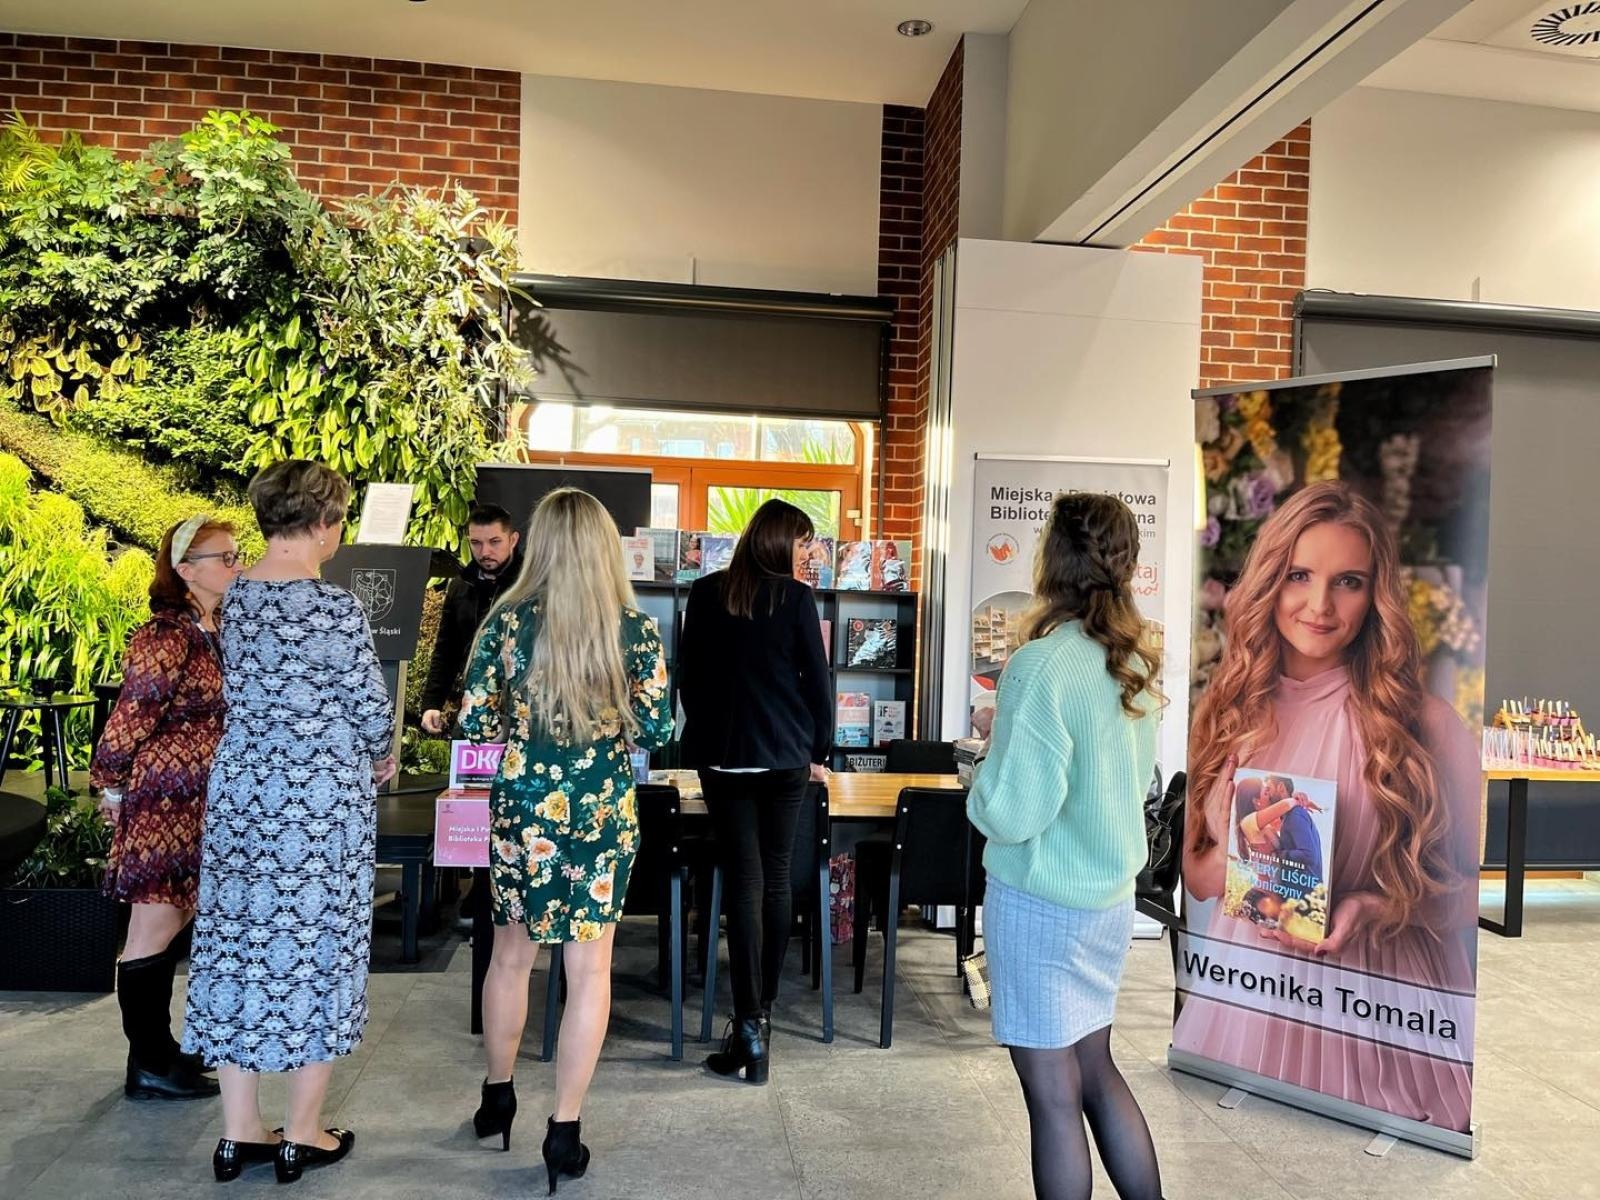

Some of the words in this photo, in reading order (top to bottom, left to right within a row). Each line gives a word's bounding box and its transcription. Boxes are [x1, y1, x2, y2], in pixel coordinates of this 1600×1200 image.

[991, 487, 1053, 504] Miejska
[990, 506, 1050, 521] Bibliote
[1281, 868, 1320, 889] LIŚCIE
[1184, 950, 1323, 1008] Weronika
[1335, 987, 1457, 1040] Tomala
